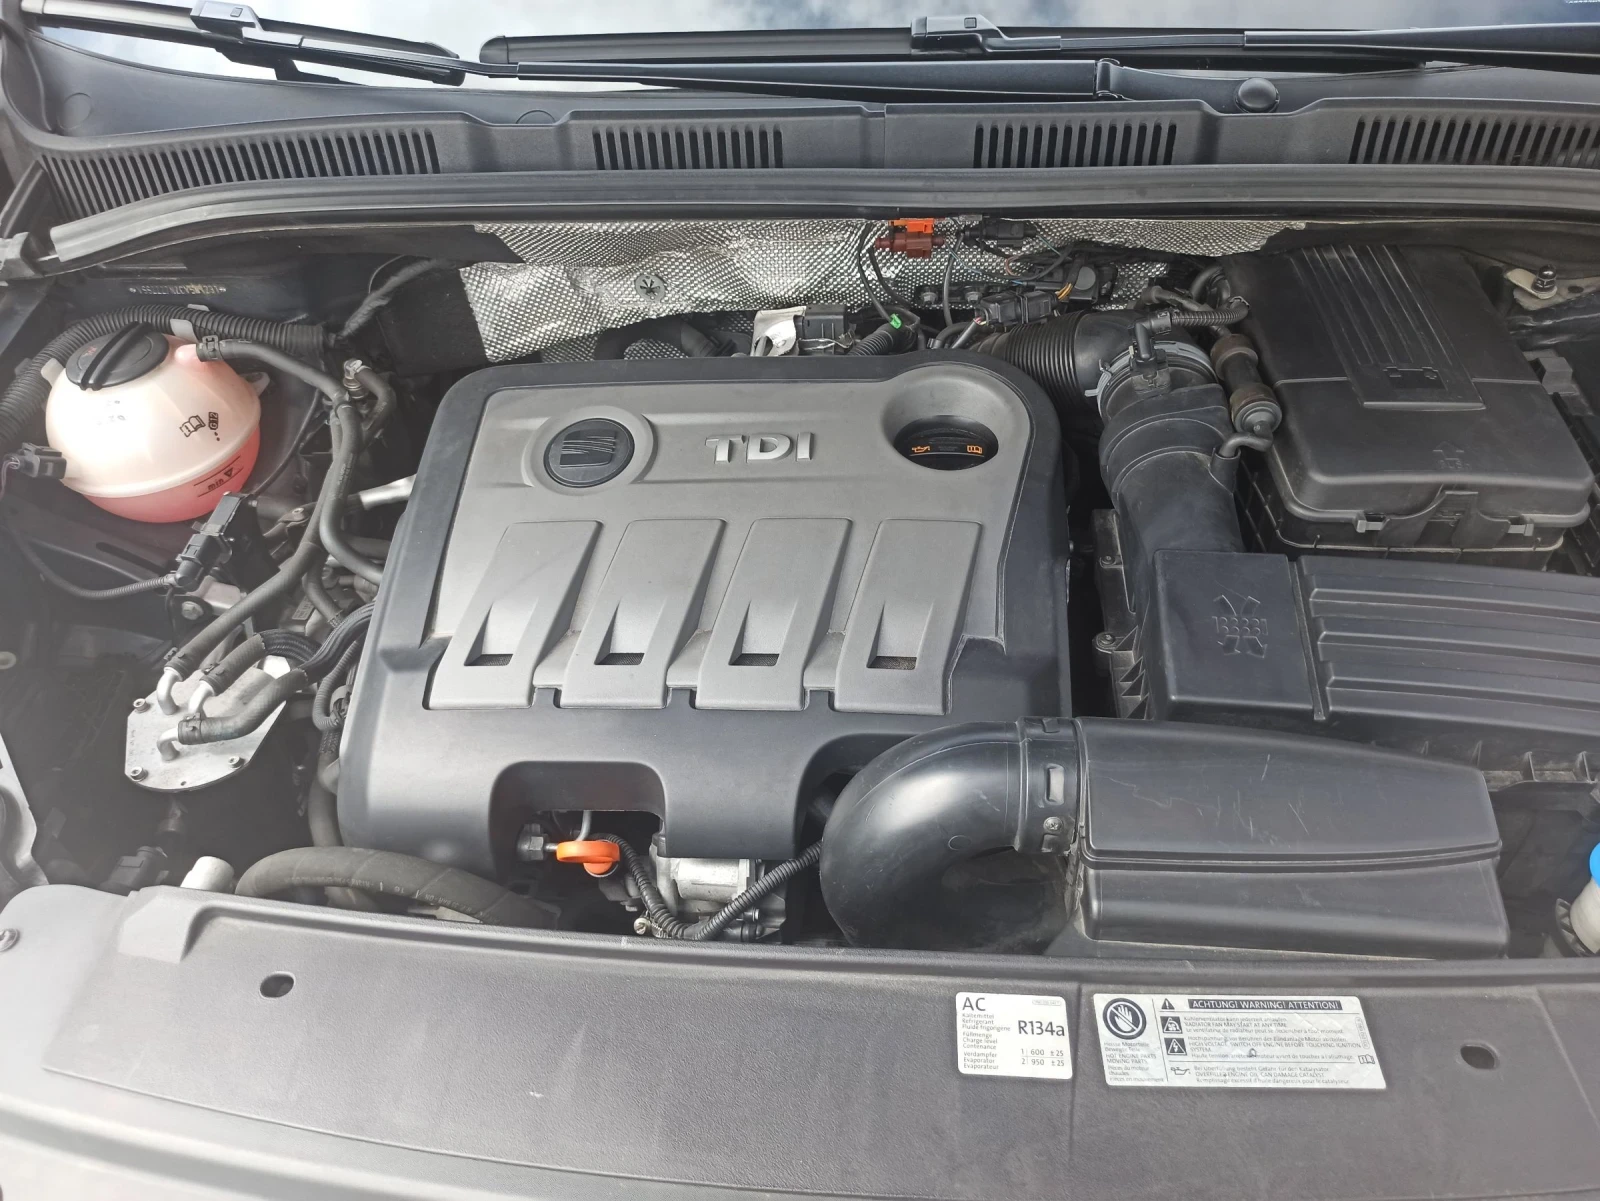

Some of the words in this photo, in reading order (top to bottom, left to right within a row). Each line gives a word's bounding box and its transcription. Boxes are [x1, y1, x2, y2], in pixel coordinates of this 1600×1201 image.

[704, 431, 815, 464] TDI
[207, 478, 225, 492] min
[962, 997, 986, 1011] AC
[1192, 1000, 1238, 1009] ACHTUNG!
[1240, 1001, 1286, 1009] WARNING!
[1288, 1001, 1338, 1009] ATTENTION!
[1018, 1020, 1065, 1036] R134a
